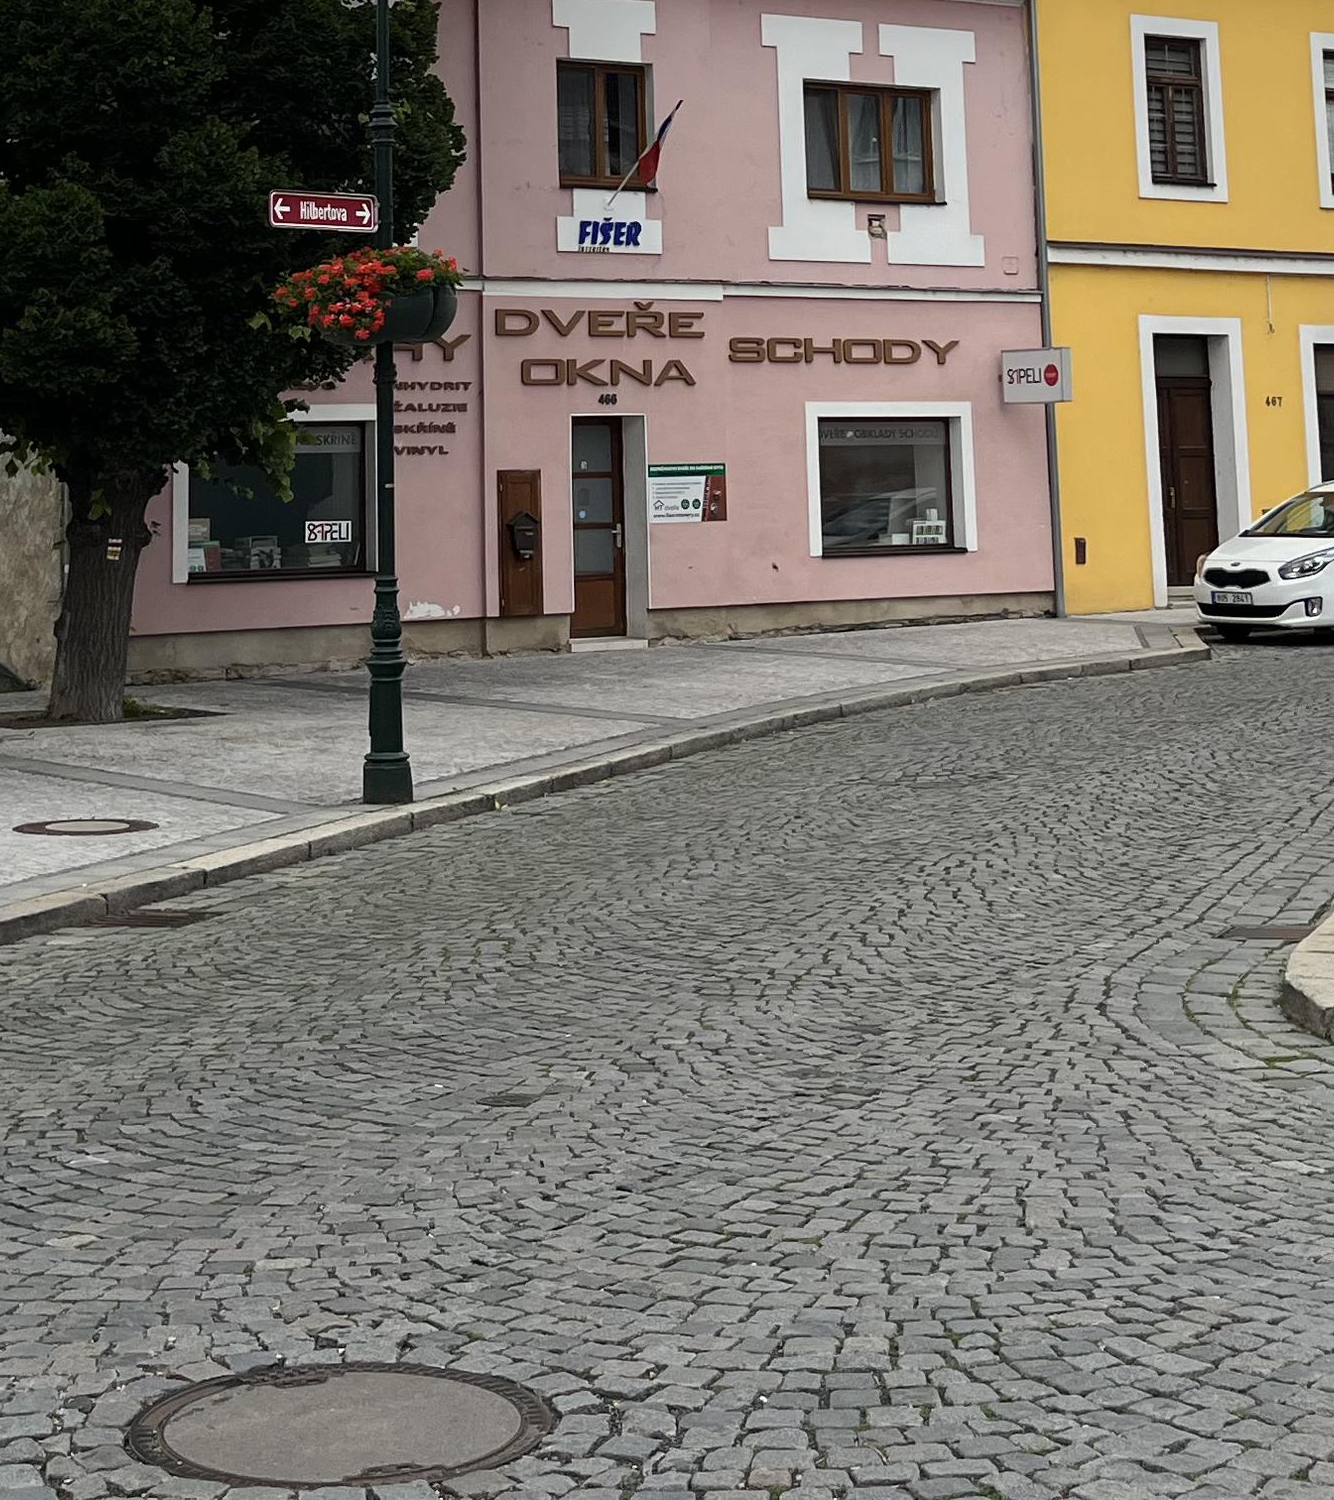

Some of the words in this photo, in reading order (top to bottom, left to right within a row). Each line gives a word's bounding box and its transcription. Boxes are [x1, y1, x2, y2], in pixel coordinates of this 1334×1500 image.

[300, 201, 347, 221] Hilbertova
[578, 217, 642, 246] FIŠER
[495, 301, 705, 338] DVEŘE
[728, 337, 960, 364] SCHODY
[521, 358, 696, 386] OKNA
[394, 381, 472, 391] NHYDRIT
[1265, 396, 1282, 407] 467
[394, 446, 449, 456] VINYL
